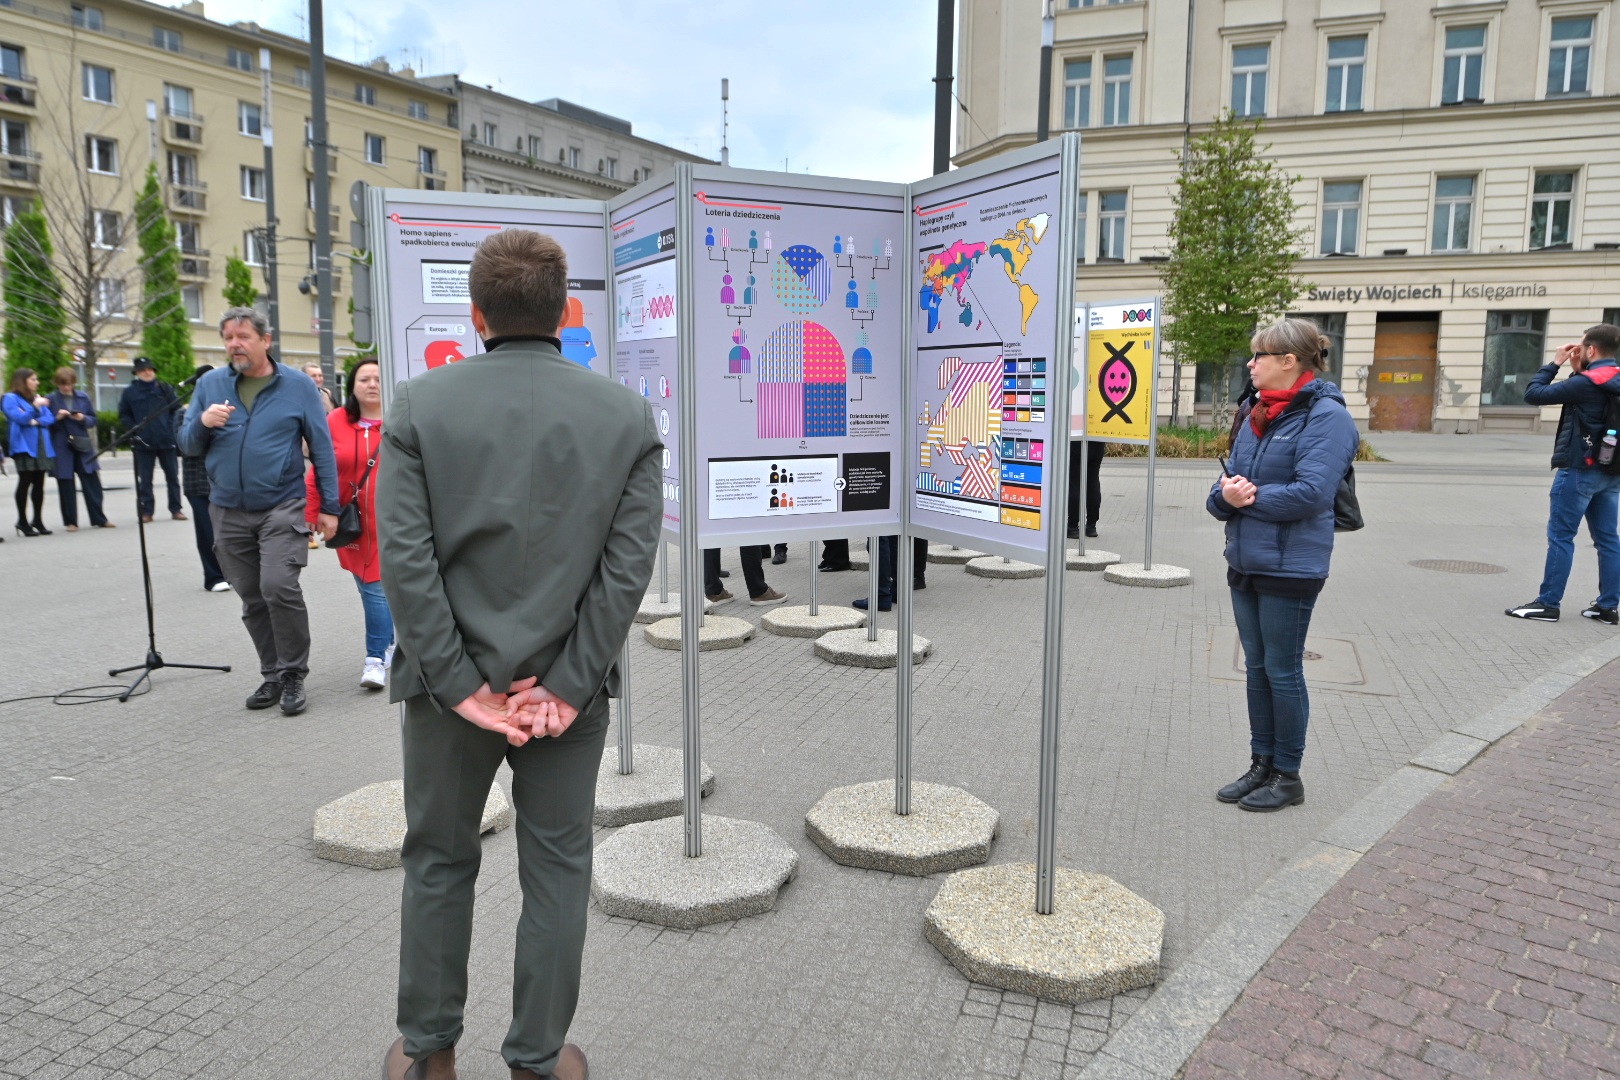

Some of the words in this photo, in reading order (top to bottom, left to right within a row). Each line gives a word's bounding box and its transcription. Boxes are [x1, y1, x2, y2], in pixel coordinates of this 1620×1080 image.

[705, 208, 731, 217] Loteria
[732, 210, 781, 220] dziedziczenia
[424, 230, 452, 238] sapiens
[400, 238, 450, 247] spadkobierca
[1366, 284, 1442, 303] Wojciech
[1462, 283, 1547, 301] księgarnia
[457, 325, 463, 333] E
